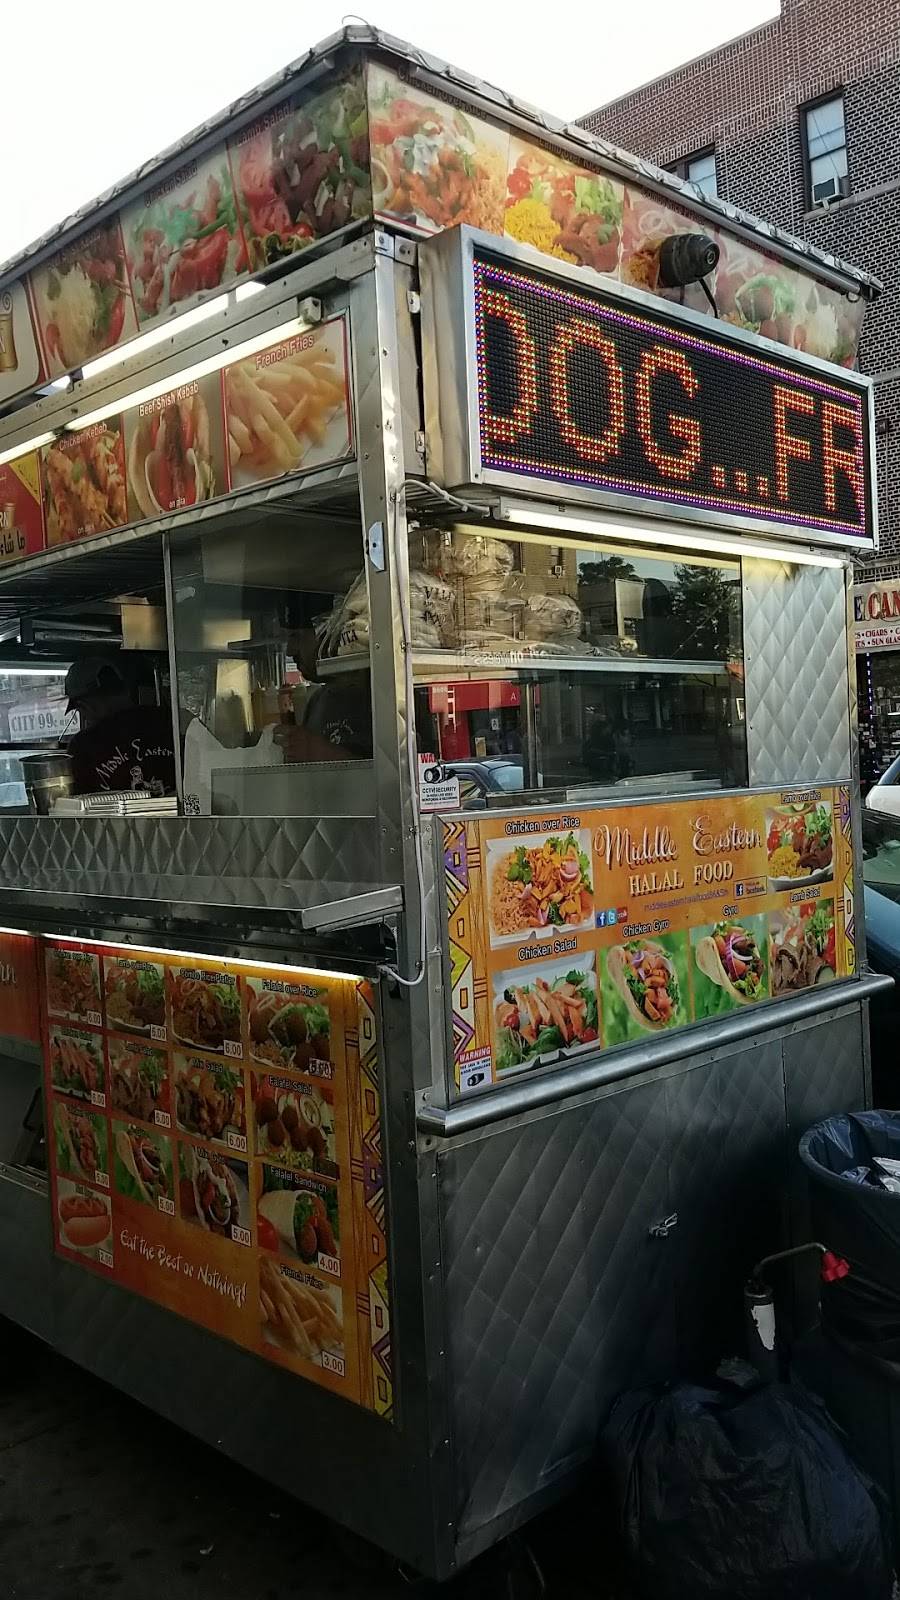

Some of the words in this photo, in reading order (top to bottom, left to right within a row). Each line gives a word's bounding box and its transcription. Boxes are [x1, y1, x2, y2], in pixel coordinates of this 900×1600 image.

[255, 345, 289, 371] French
[290, 334, 314, 358] Fries
[139, 402, 156, 417] Beef
[157, 392, 175, 411] Shish
[177, 381, 199, 400] Kebab
[58, 432, 84, 451] Chicken
[86, 422, 107, 442] Kebab
[12, 714, 35, 732] CITY
[505, 820, 540, 835] Chicken
[542, 820, 560, 832] over
[561, 816, 580, 830] Rice
[594, 825, 677, 871] Middle
[690, 815, 763, 857] Eastern
[629, 870, 685, 897] HALAL
[693, 861, 734, 887] FOOD
[723, 904, 739, 917] Gyro
[622, 922, 652, 938] Chicken
[653, 918, 670, 933] Gyro
[518, 944, 552, 961] Chicken
[554, 939, 577, 954] Salad
[262, 979, 284, 992] Falafel
[285, 984, 299, 994] over
[302, 986, 318, 997] Rice
[459, 1046, 491, 1063] WARNING
[269, 1076, 291, 1089] Falafel
[229, 1136, 246, 1149] 6.00
[270, 1166, 293, 1181] Falafel
[295, 1173, 327, 1193] Sandwich
[233, 1227, 249, 1243] 5.00
[120, 1229, 137, 1251] Eat
[156, 1244, 183, 1272] Best
[197, 1264, 247, 1308] Nothing!
[320, 1257, 339, 1273] 4.00
[324, 1355, 342, 1373] 3.00
